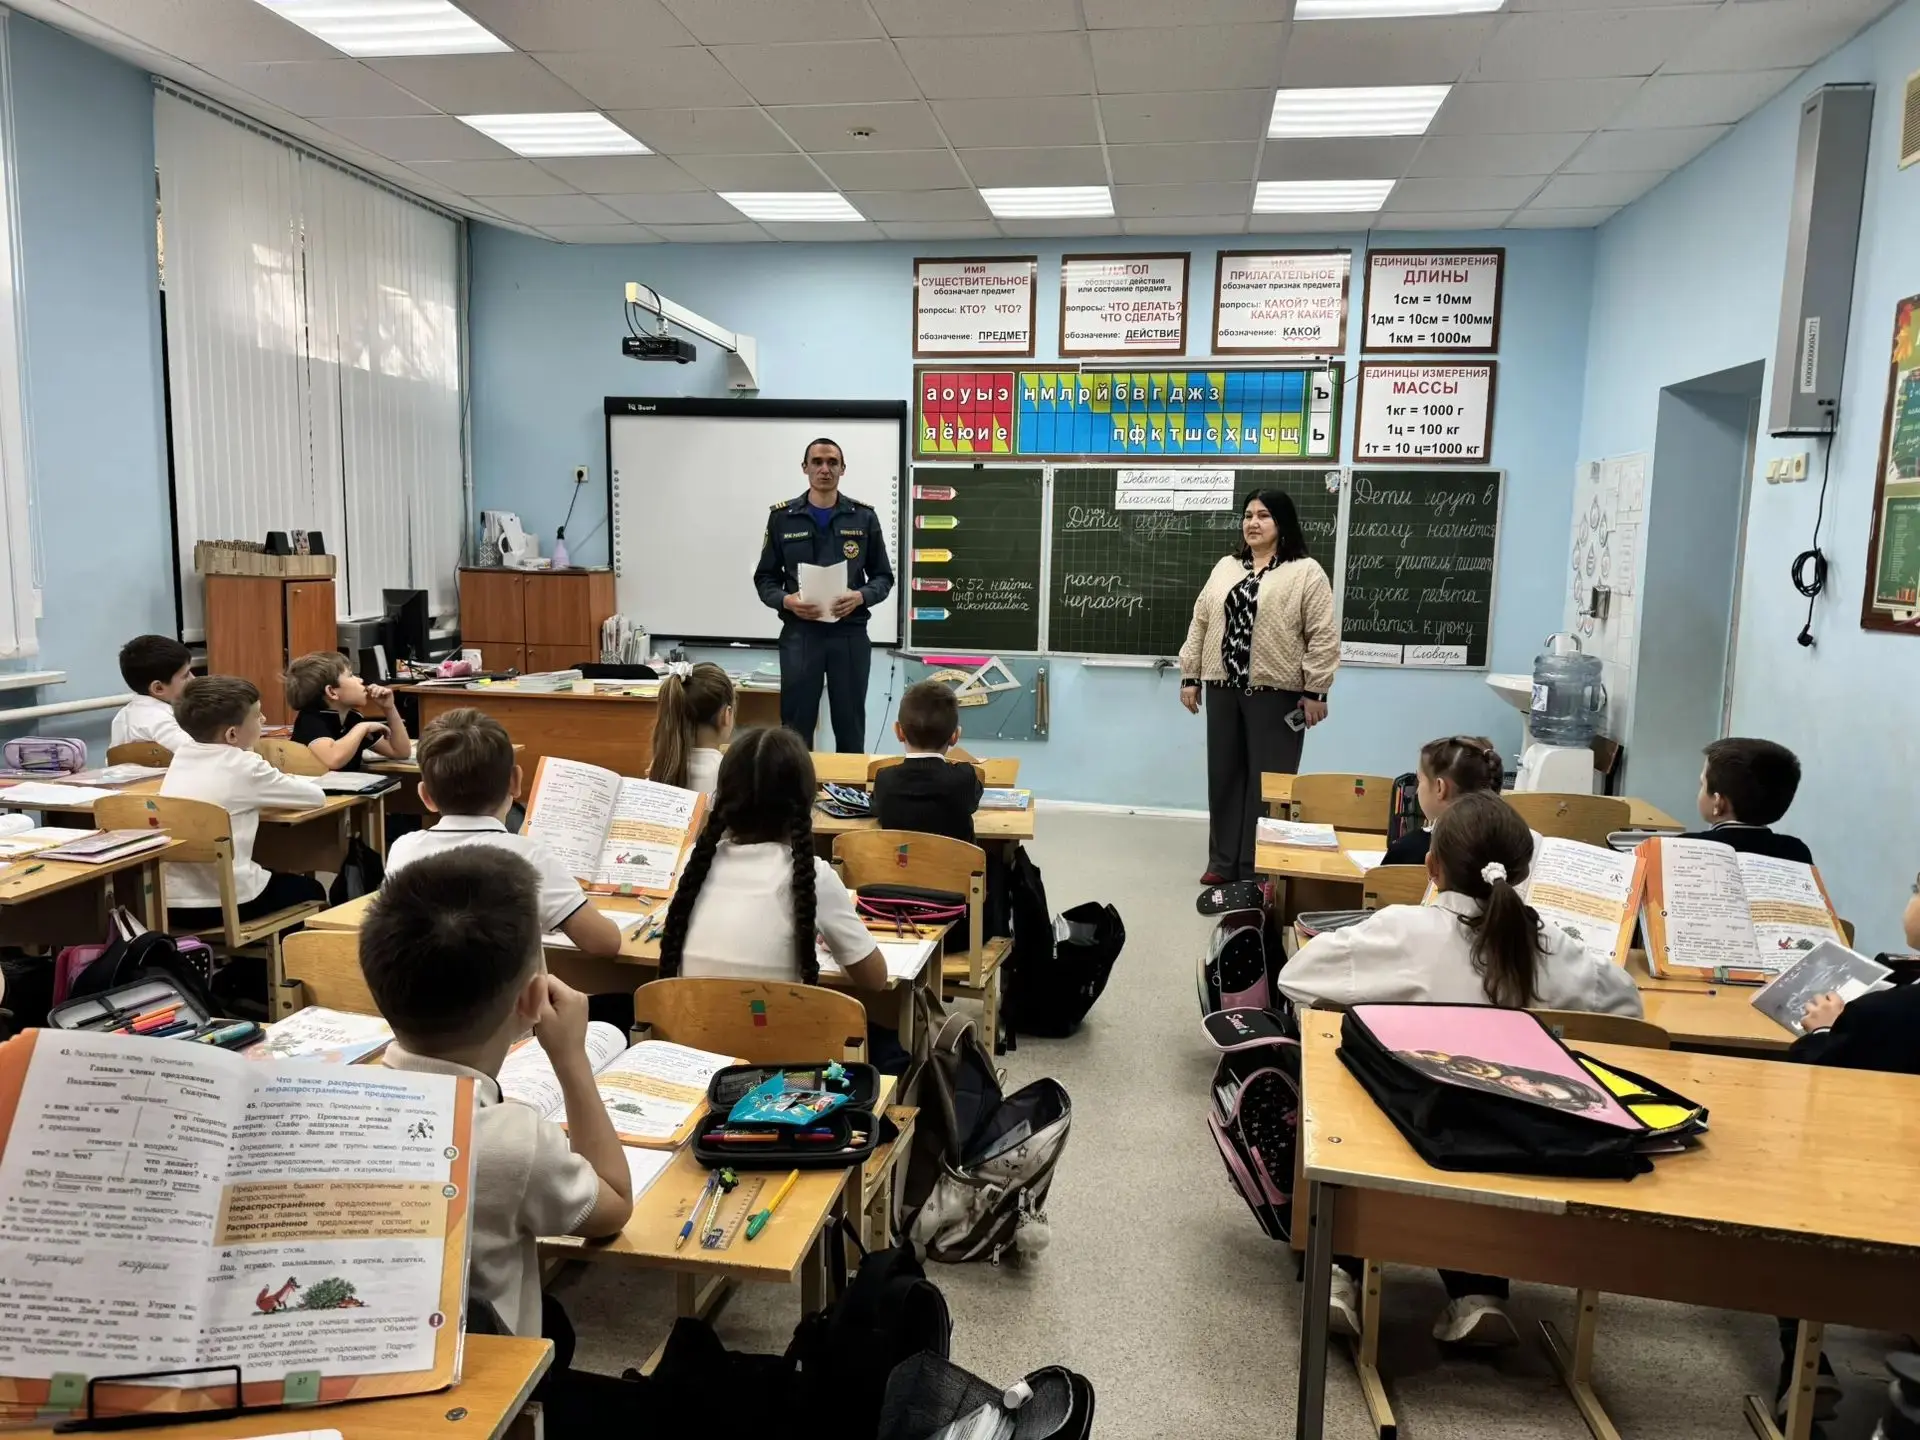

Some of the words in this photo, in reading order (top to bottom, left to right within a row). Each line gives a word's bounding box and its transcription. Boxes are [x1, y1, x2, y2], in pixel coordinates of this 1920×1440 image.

[1373, 257, 1427, 267] ЕДИНИЦЫ
[1430, 256, 1497, 266] ИЗМЕРЕНИЯ
[964, 265, 986, 274] ИМЯ
[1230, 270, 1335, 280] ПРИЛАГАТЕЛЬНОЕ
[922, 276, 1029, 287] СУЩЕСТВИТЕЛЬНОЕ
[1129, 278, 1165, 286] действие
[1404, 270, 1468, 285] ДЛИНЫ
[983, 288, 1015, 296] предмет
[1264, 298, 1308, 308] КАКОЙ?
[1312, 297, 1340, 308] ЧЕЙ?
[1394, 294, 1419, 304] 1см
[1436, 294, 1472, 305] 10мм
[919, 306, 957, 315] вопросы:
[960, 305, 986, 314] КТО?
[995, 304, 1021, 314] ЧТО?
[1066, 305, 1105, 314] вопросы:
[1108, 302, 1129, 311] ЧТО
[1132, 301, 1182, 313] ДЕЛАТЬ?
[1101, 313, 1122, 322] ЧТО
[1125, 312, 1182, 323] СДЕЛАТЬ?
[1250, 310, 1295, 319] КАКАЯ?
[1297, 310, 1340, 319] КАКИЕ?
[1371, 314, 1394, 326] 1дм
[1409, 314, 1438, 324] 10см
[1453, 314, 1492, 325] 100мм
[920, 332, 973, 341] обозначение:
[978, 331, 1027, 342] ПРЕДМЕТ
[1065, 331, 1120, 339] обозначение:
[1125, 328, 1180, 341] ДЕЙСТВИЕ
[1283, 326, 1320, 336] КАКОЙ
[1388, 332, 1414, 343] 1км
[1430, 332, 1471, 344] 1000м
[1366, 369, 1419, 378] ЕДИНИЦЫ
[1423, 369, 1488, 377] ИЗМЕРЕНИЯ
[1393, 382, 1458, 394] МАССЫ
[1386, 405, 1406, 416] 1кг
[1423, 405, 1453, 416] 1000
[1458, 408, 1464, 416] г
[1388, 424, 1402, 436] 1ц
[1420, 424, 1443, 435] 100
[1447, 427, 1460, 435] кг
[1365, 443, 1379, 454] 1т
[1396, 443, 1410, 454] 10
[1466, 446, 1480, 454] кг
[1355, 478, 1412, 505] Дети
[1425, 490, 1477, 516] идут
[1482, 484, 1495, 504] в
